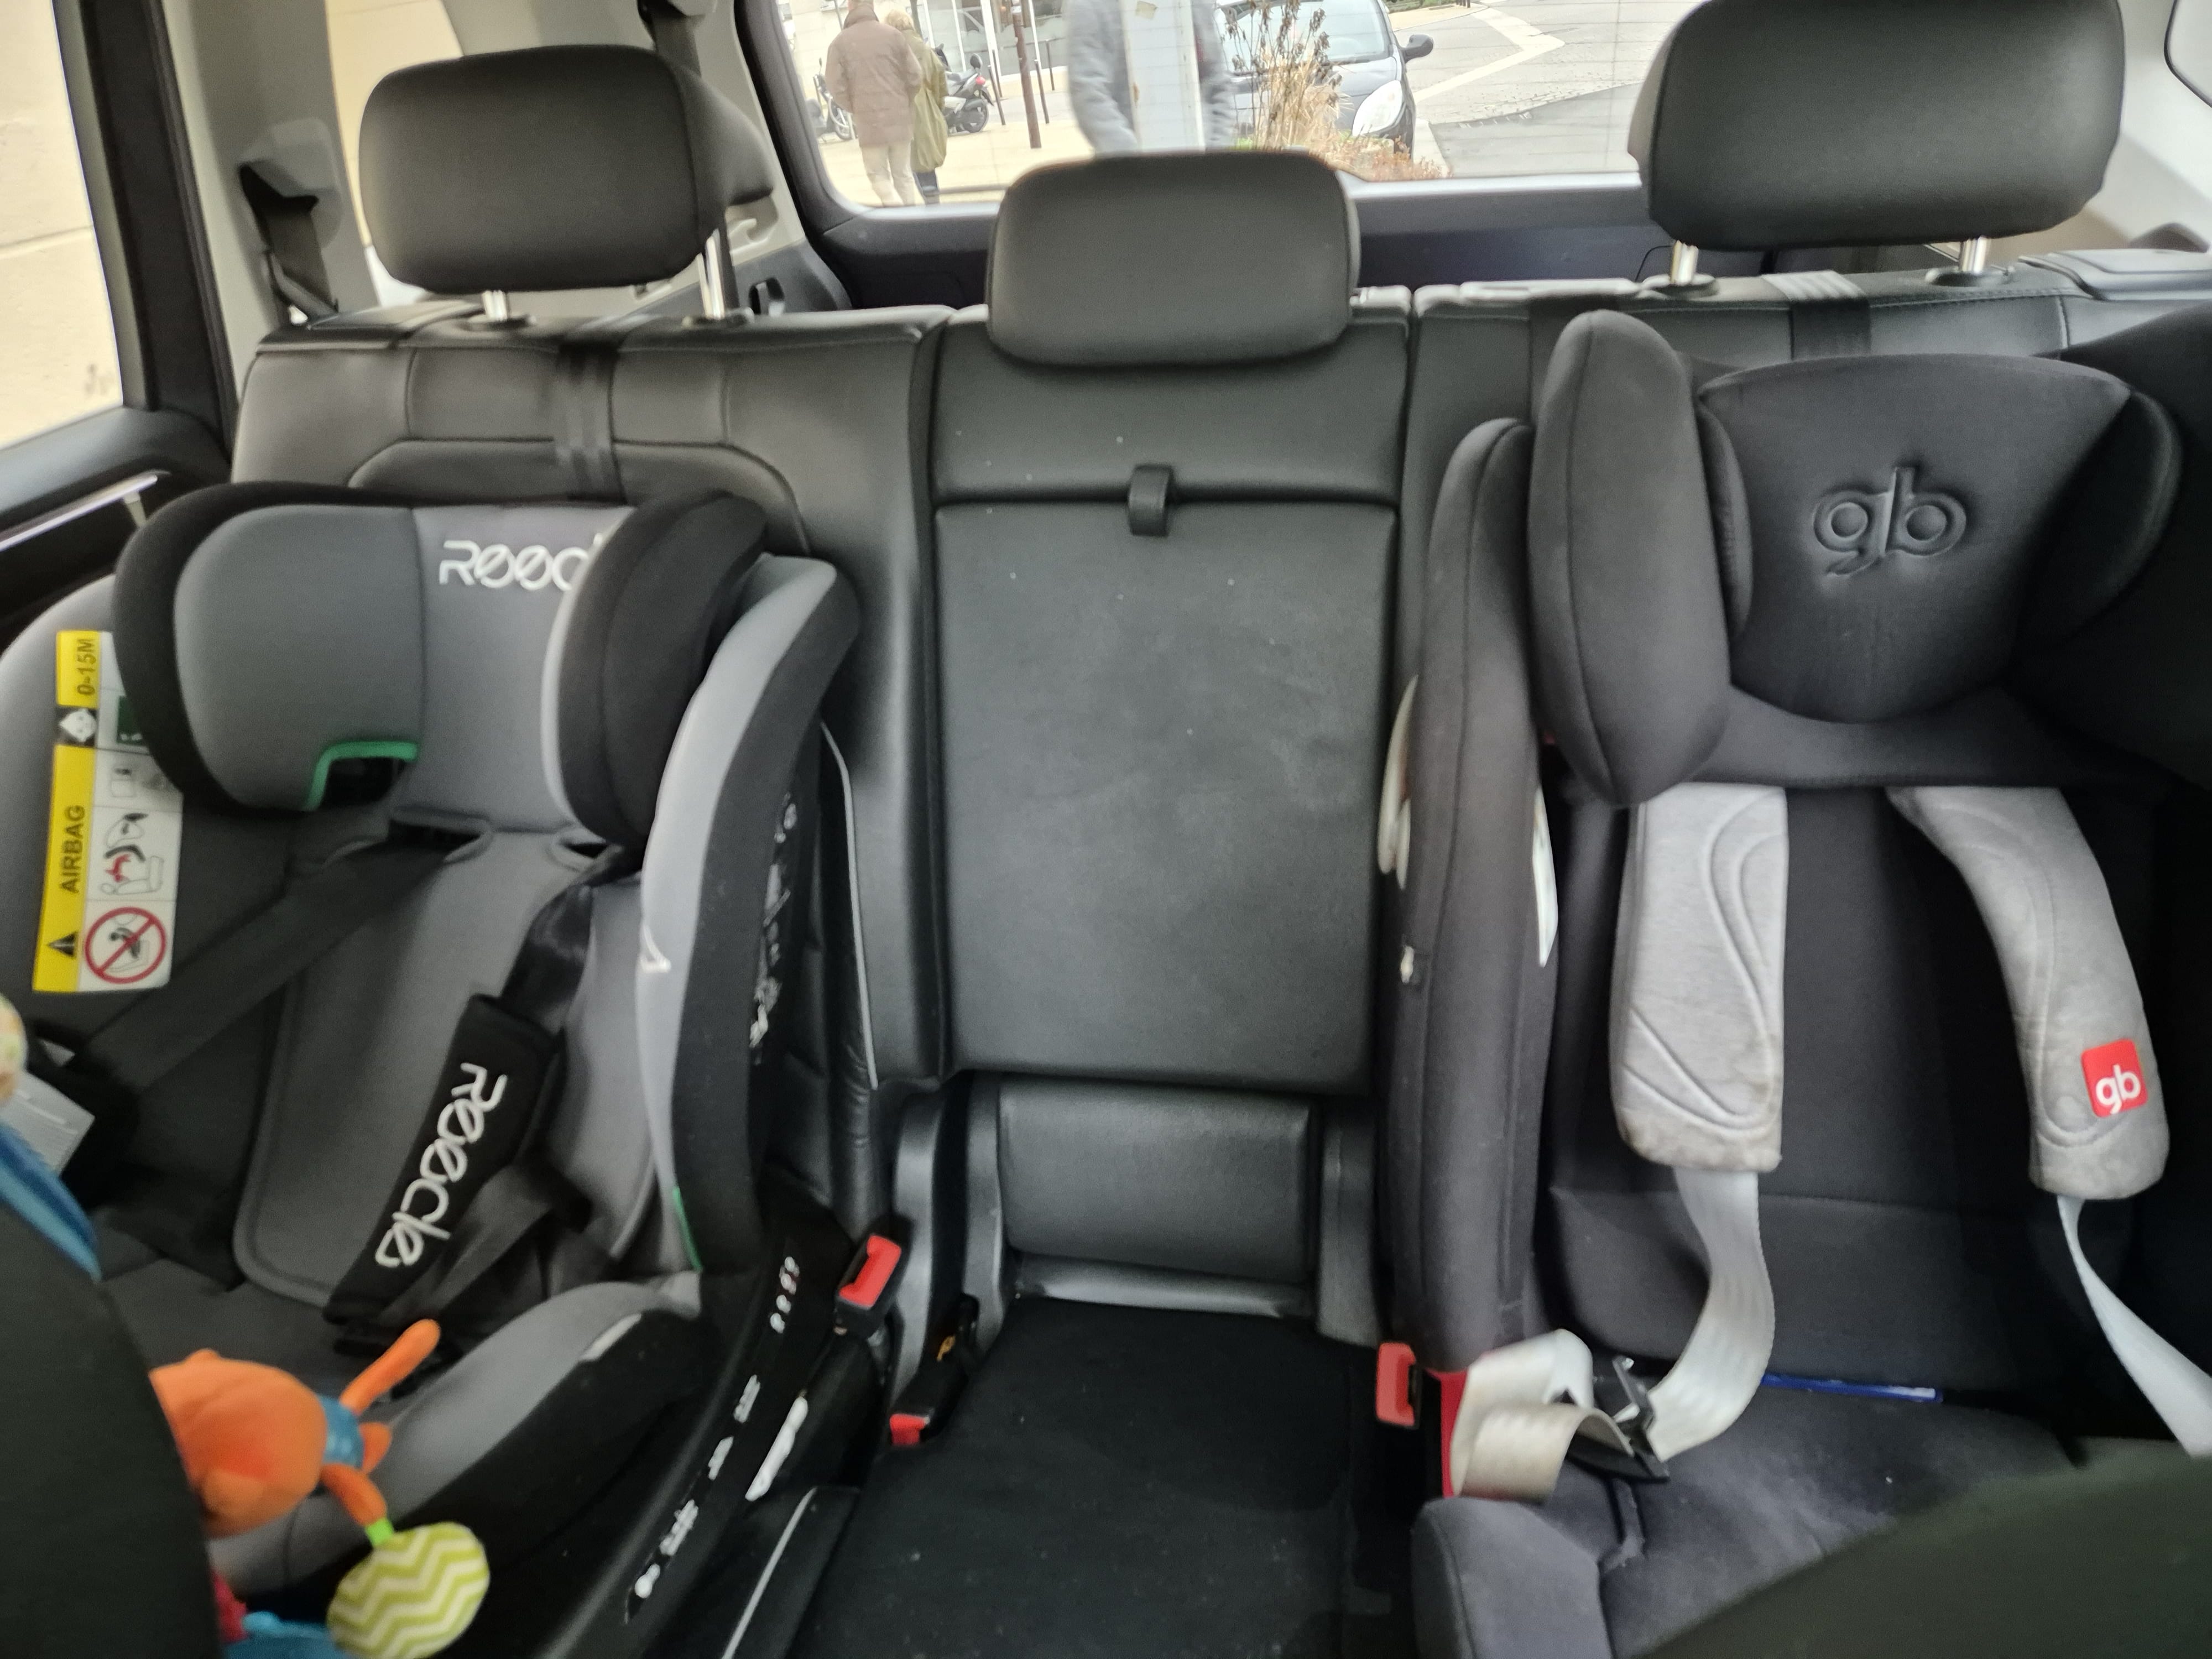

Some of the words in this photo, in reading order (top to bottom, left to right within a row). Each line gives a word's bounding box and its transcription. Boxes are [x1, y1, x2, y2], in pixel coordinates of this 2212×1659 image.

[1813, 466, 1966, 577] gb
[76, 638, 96, 696] 0-15M
[59, 804, 86, 894] AIRBAG
[2096, 1063, 2141, 1114] gb
